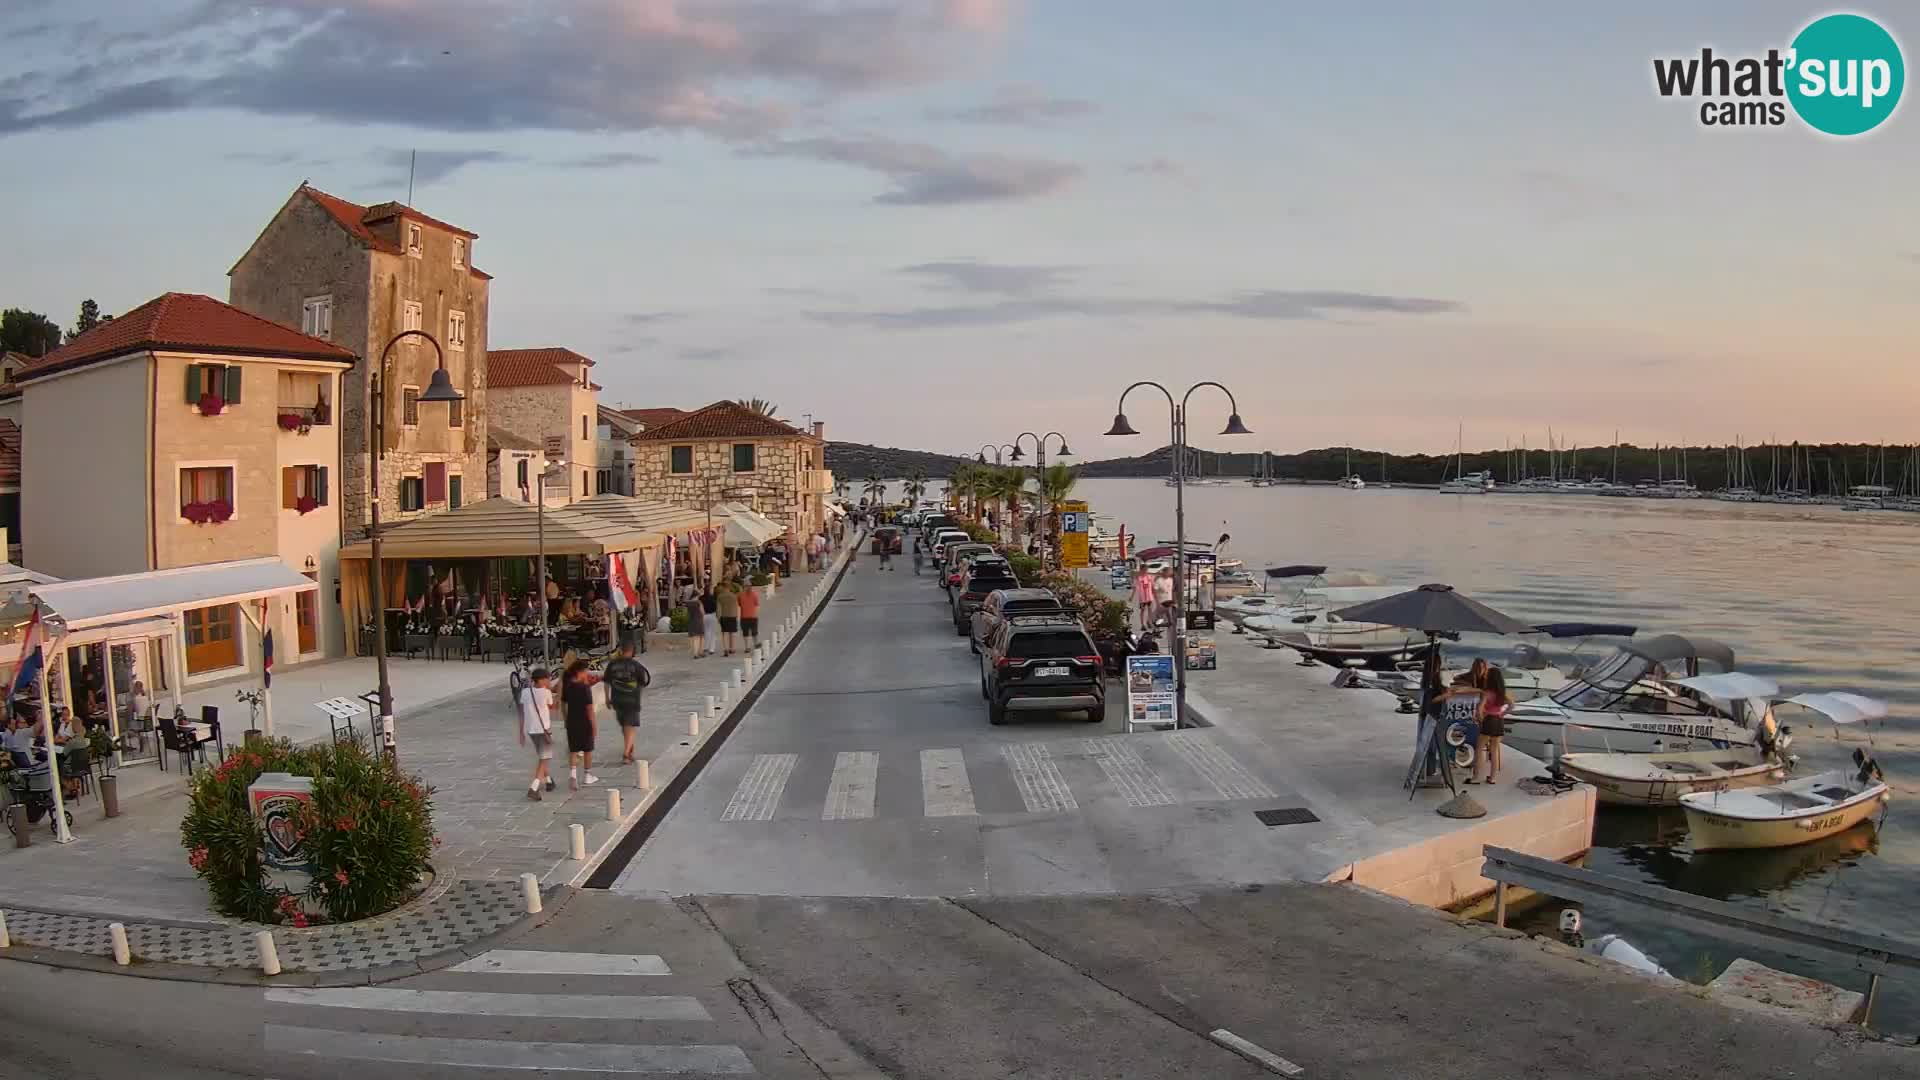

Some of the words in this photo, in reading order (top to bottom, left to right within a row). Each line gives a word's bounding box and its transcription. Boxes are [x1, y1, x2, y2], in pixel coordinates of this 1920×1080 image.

[1065, 514, 1075, 530] P
[1667, 724, 1688, 734] RENT
[1695, 725, 1713, 737] BOAT
